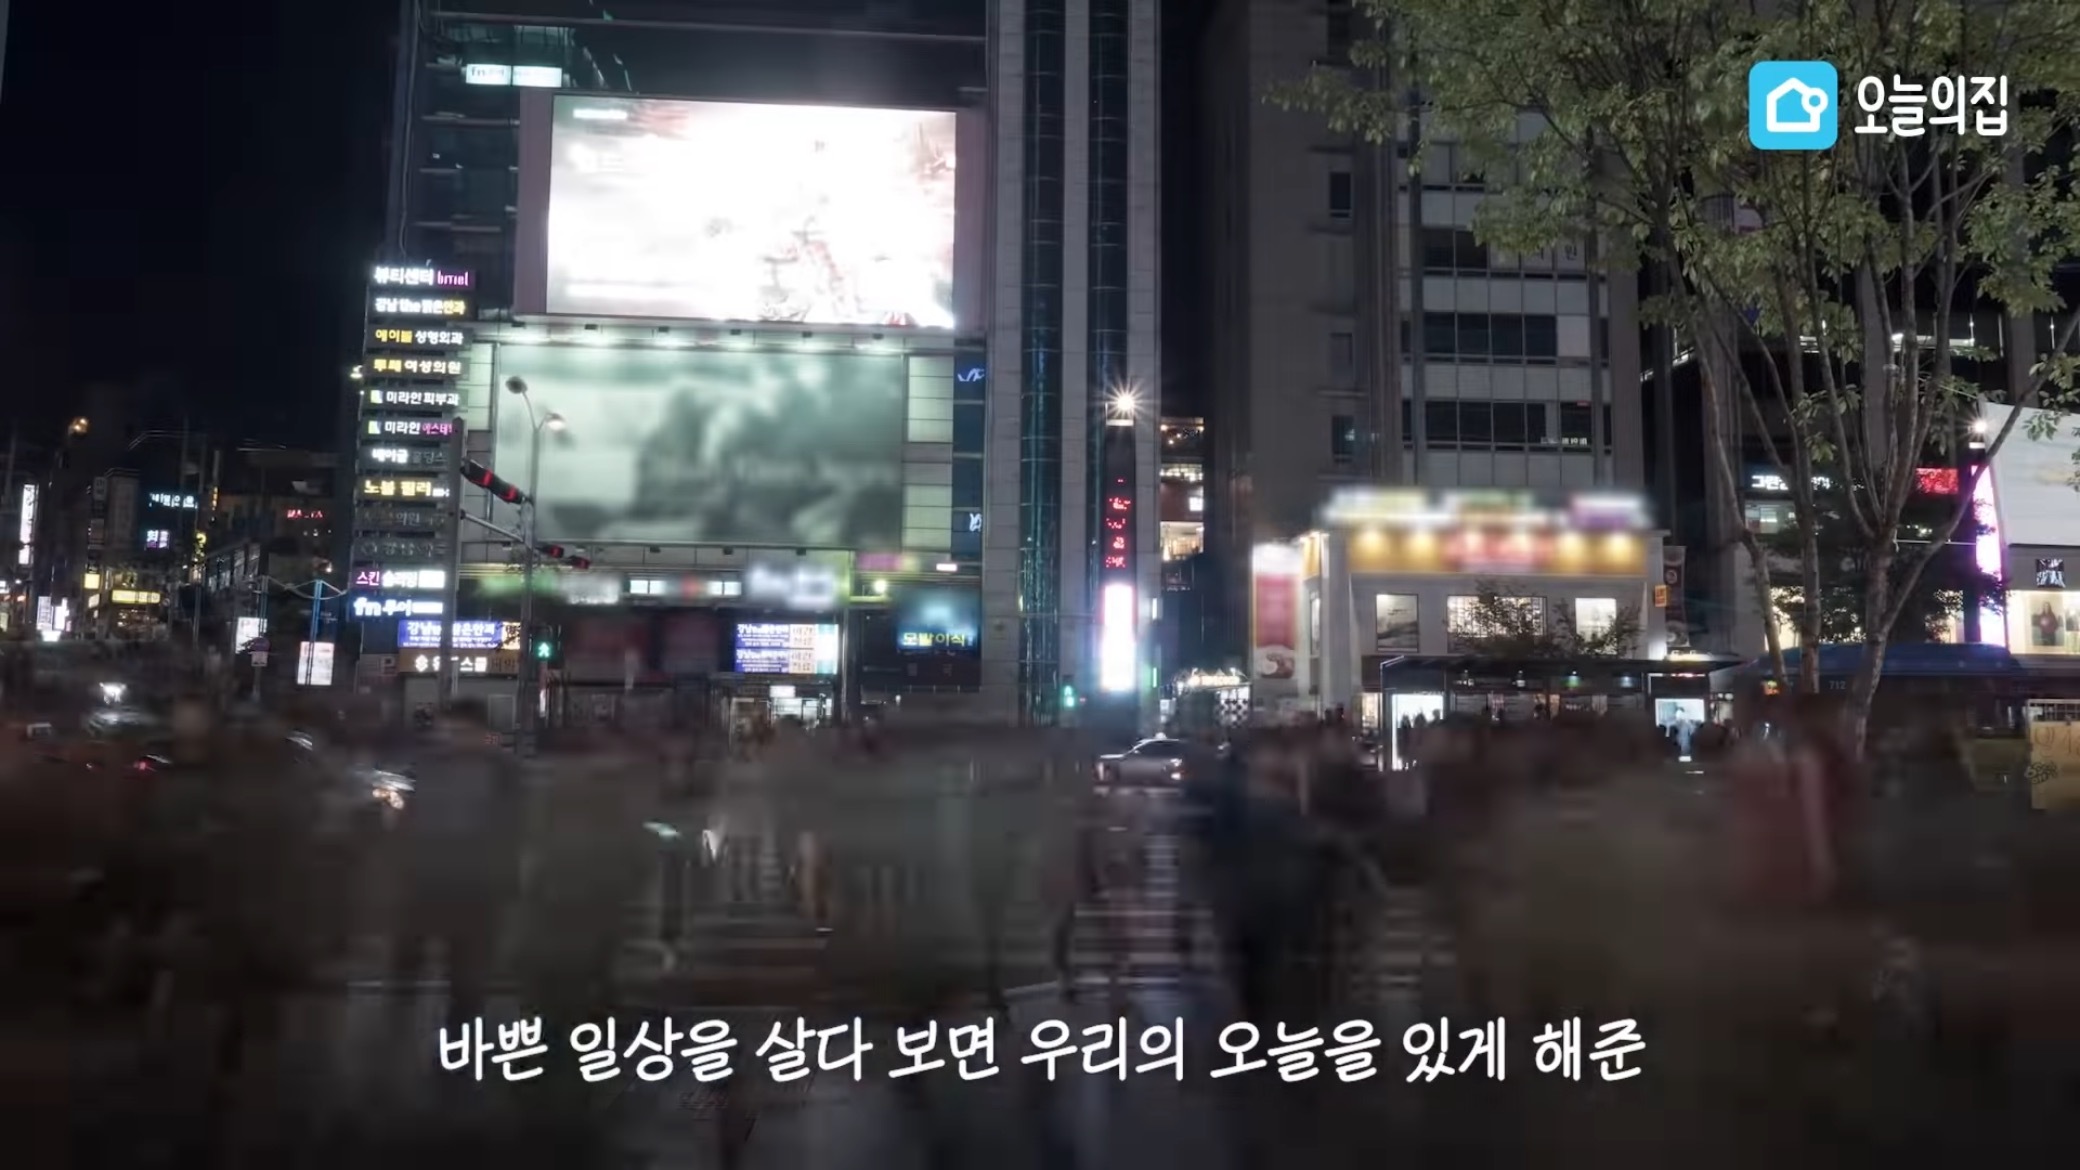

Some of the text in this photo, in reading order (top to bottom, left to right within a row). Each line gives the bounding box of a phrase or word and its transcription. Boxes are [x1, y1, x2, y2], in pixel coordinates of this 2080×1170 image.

[374, 267, 434, 285] 뷰티센터
[375, 329, 464, 345] 에이블 성형외과
[404, 360, 462, 375] 여성의원
[386, 391, 459, 406] 미라인 피부과
[384, 421, 420, 435] 미라인
[356, 571, 380, 586] 스킨
